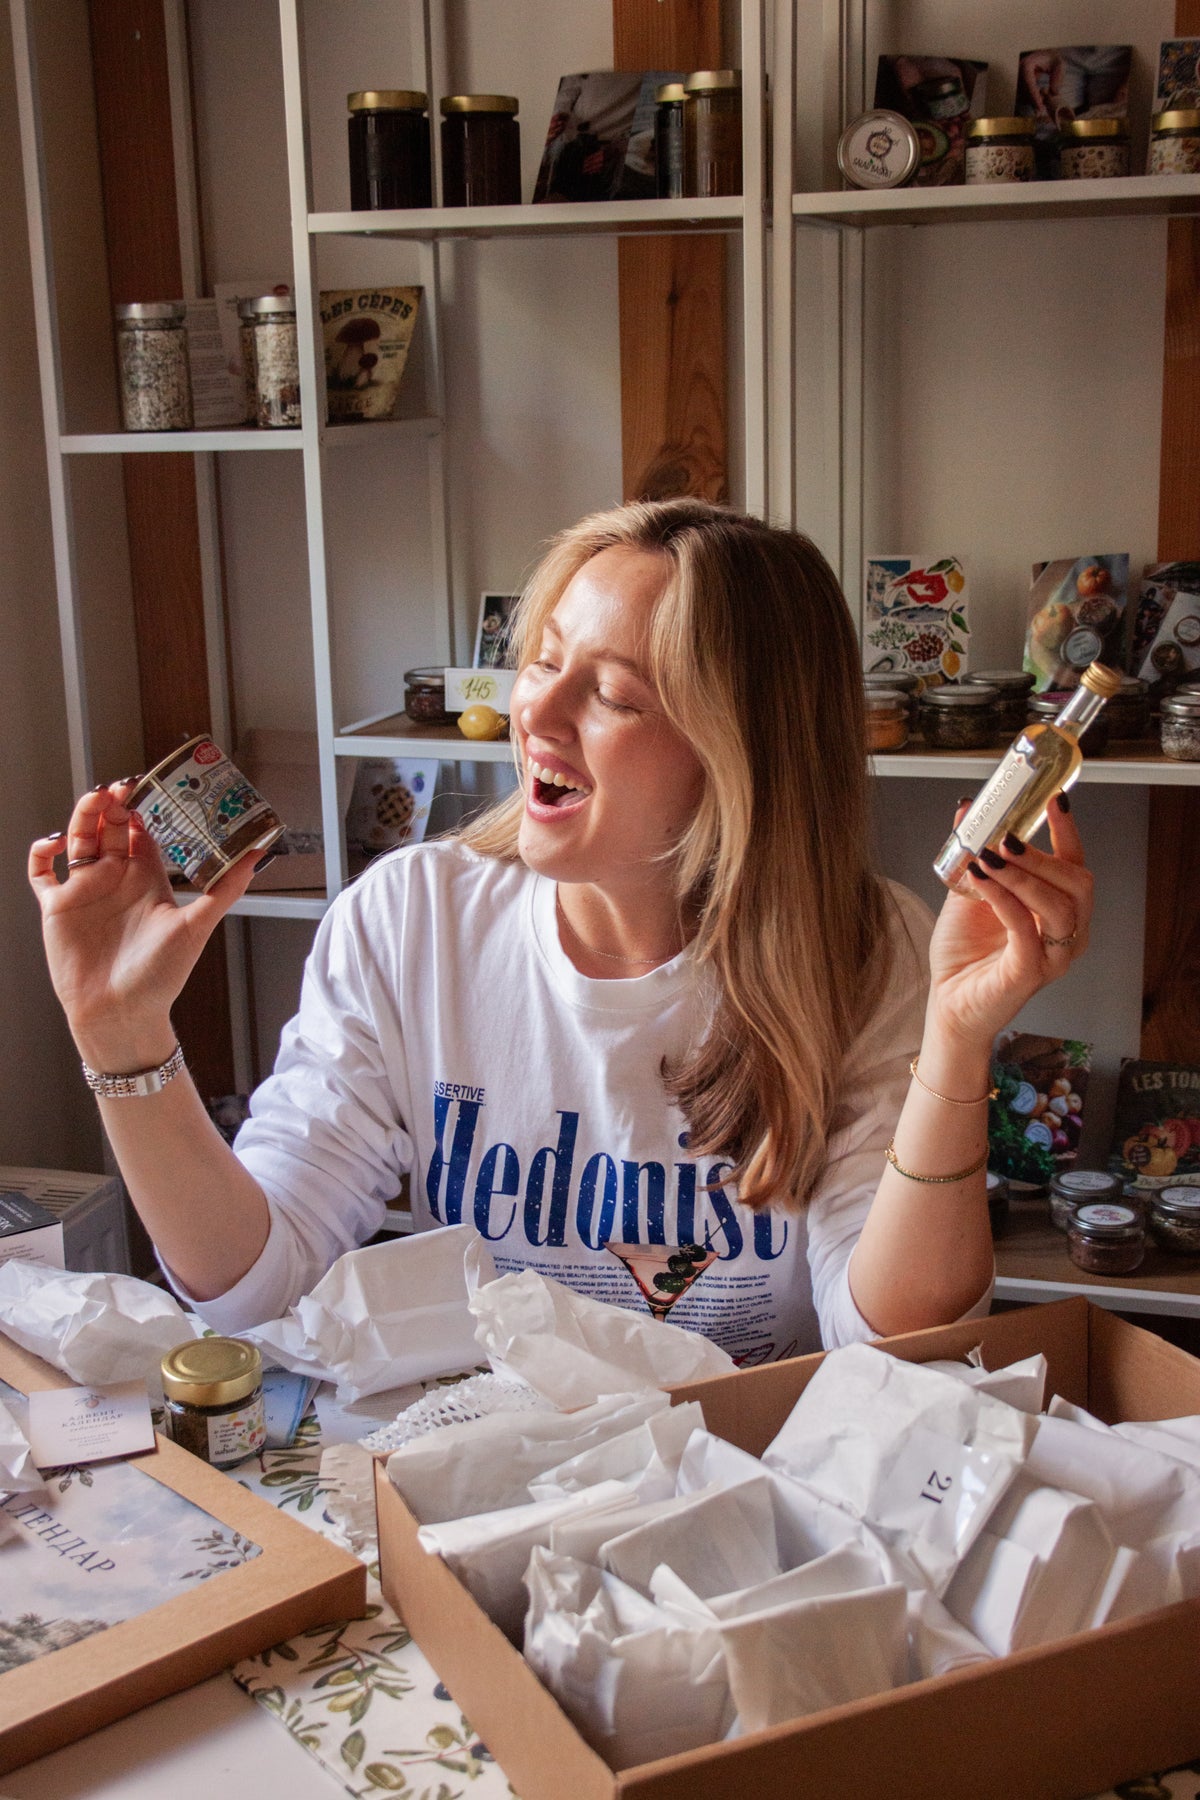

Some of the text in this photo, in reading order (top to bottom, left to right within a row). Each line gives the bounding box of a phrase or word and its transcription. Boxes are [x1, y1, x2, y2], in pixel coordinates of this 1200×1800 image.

[465, 678, 494, 700] 145
[1132, 1071, 1164, 1092] LES
[919, 1470, 952, 1504] 21
